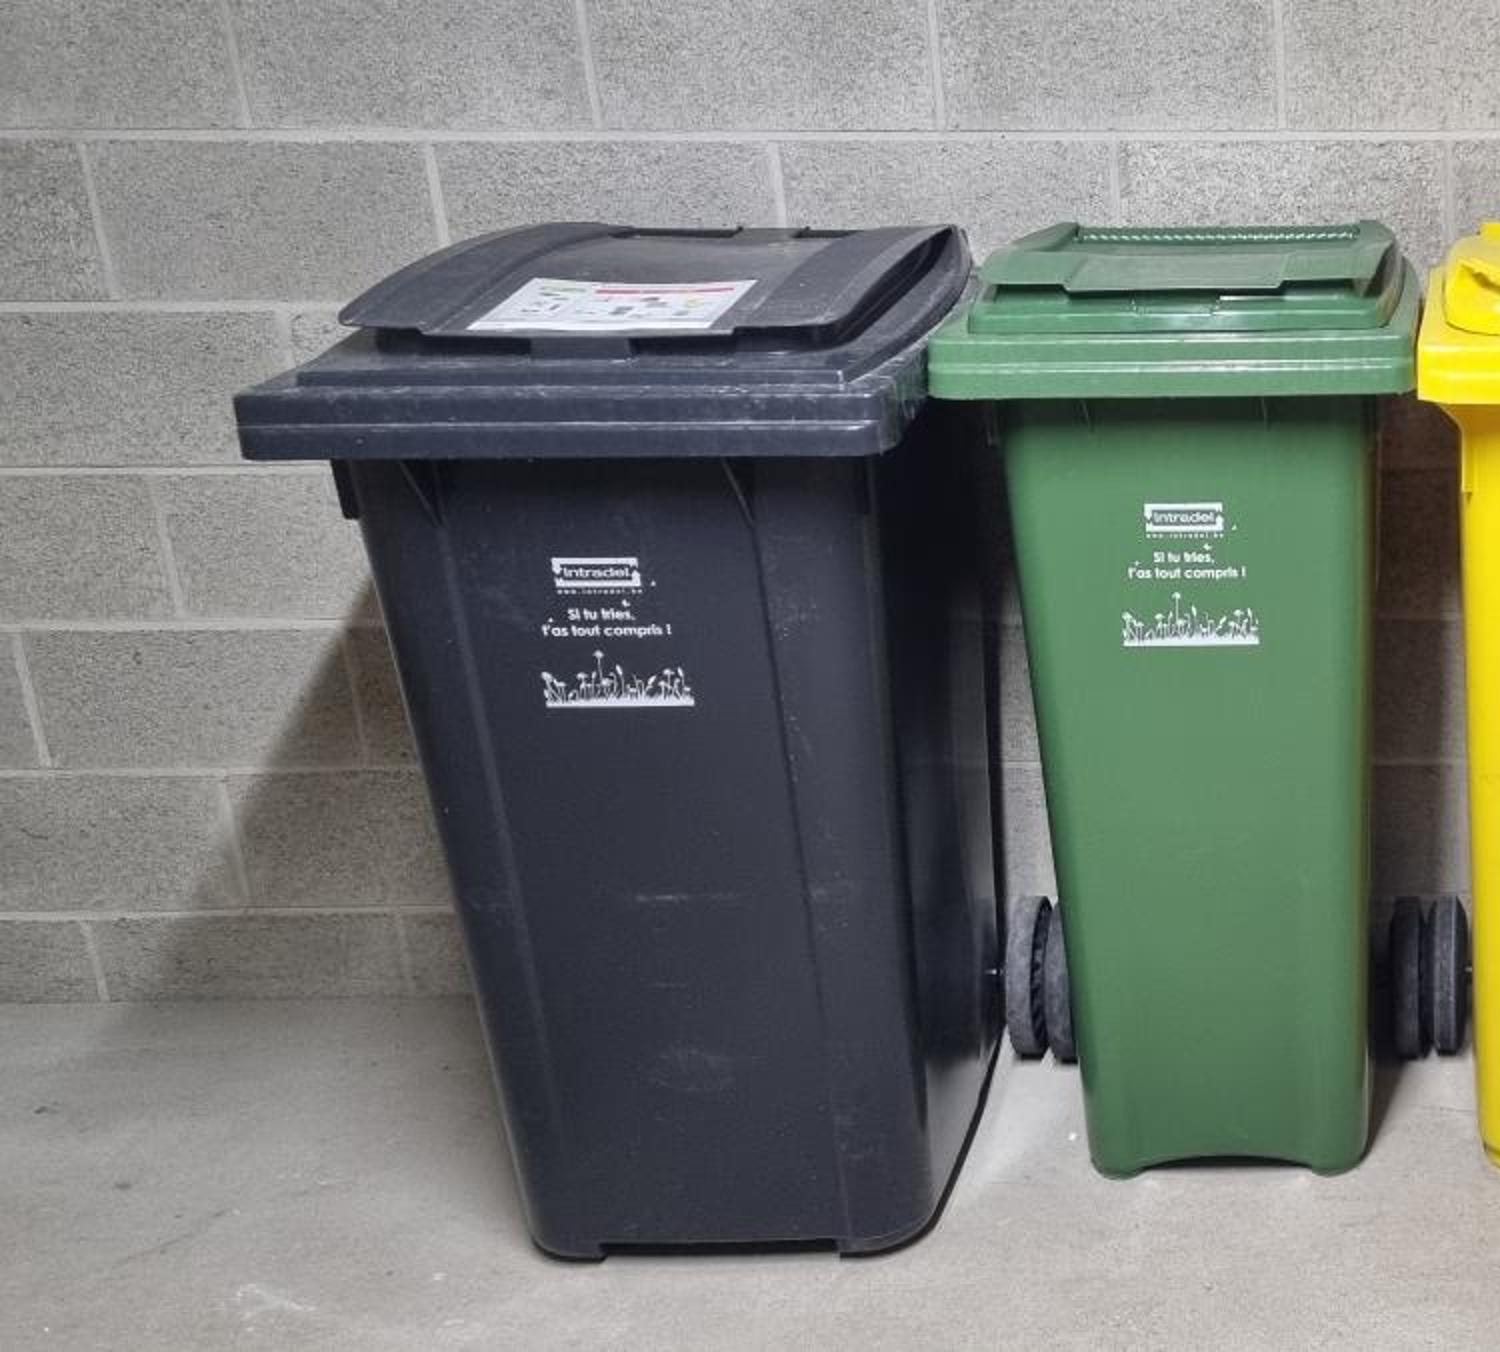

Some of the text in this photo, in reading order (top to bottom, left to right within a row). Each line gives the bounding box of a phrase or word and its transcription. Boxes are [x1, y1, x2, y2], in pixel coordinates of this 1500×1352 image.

[1153, 512, 1215, 523] Intradel
[1153, 552, 1215, 564] Si tu tries,
[563, 568, 630, 577] Intradel
[1127, 568, 1153, 579] t'as
[1154, 568, 1182, 580] tout
[1183, 567, 1239, 580] compris
[568, 608, 580, 620] Si
[583, 609, 597, 620] tu
[542, 625, 568, 637] t'as
[571, 625, 600, 636] tout
[604, 624, 663, 638] compris
